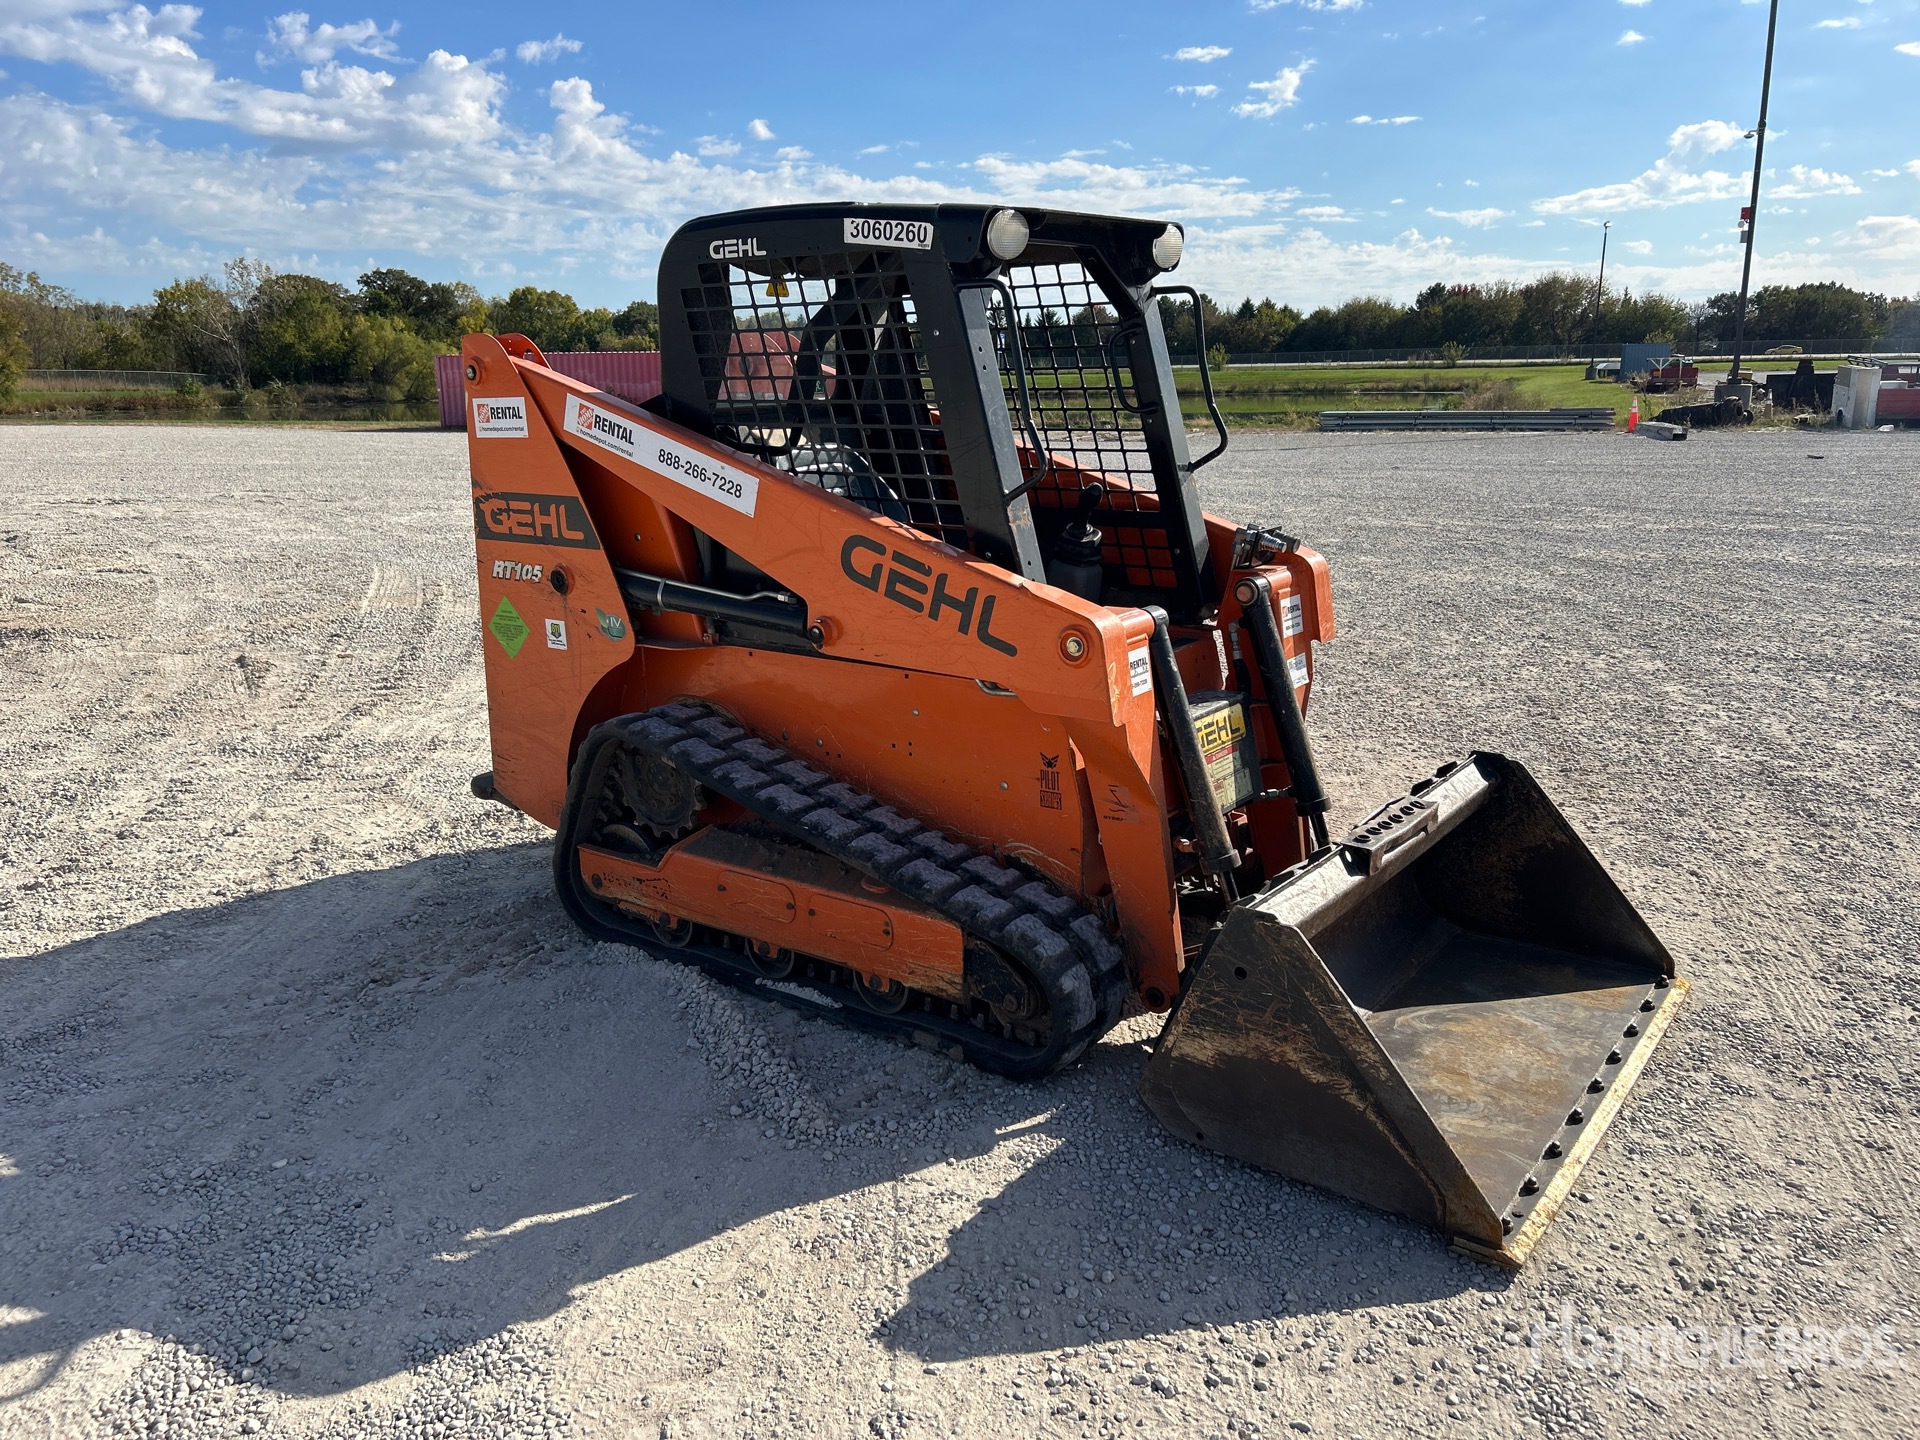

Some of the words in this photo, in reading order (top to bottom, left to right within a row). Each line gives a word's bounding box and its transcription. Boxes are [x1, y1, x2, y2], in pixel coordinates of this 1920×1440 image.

[849, 218, 928, 244] 3060260
[709, 237, 767, 260] GEHL
[490, 406, 523, 420] RENTAL
[579, 428, 634, 458] homedepot.com/rental
[593, 414, 635, 446] RENTAL
[658, 448, 743, 499] 888-266-7228
[479, 498, 585, 541] GEHL
[492, 560, 543, 583] RT105
[840, 534, 1018, 658] GEHL
[1040, 769, 1061, 792] PILOT
